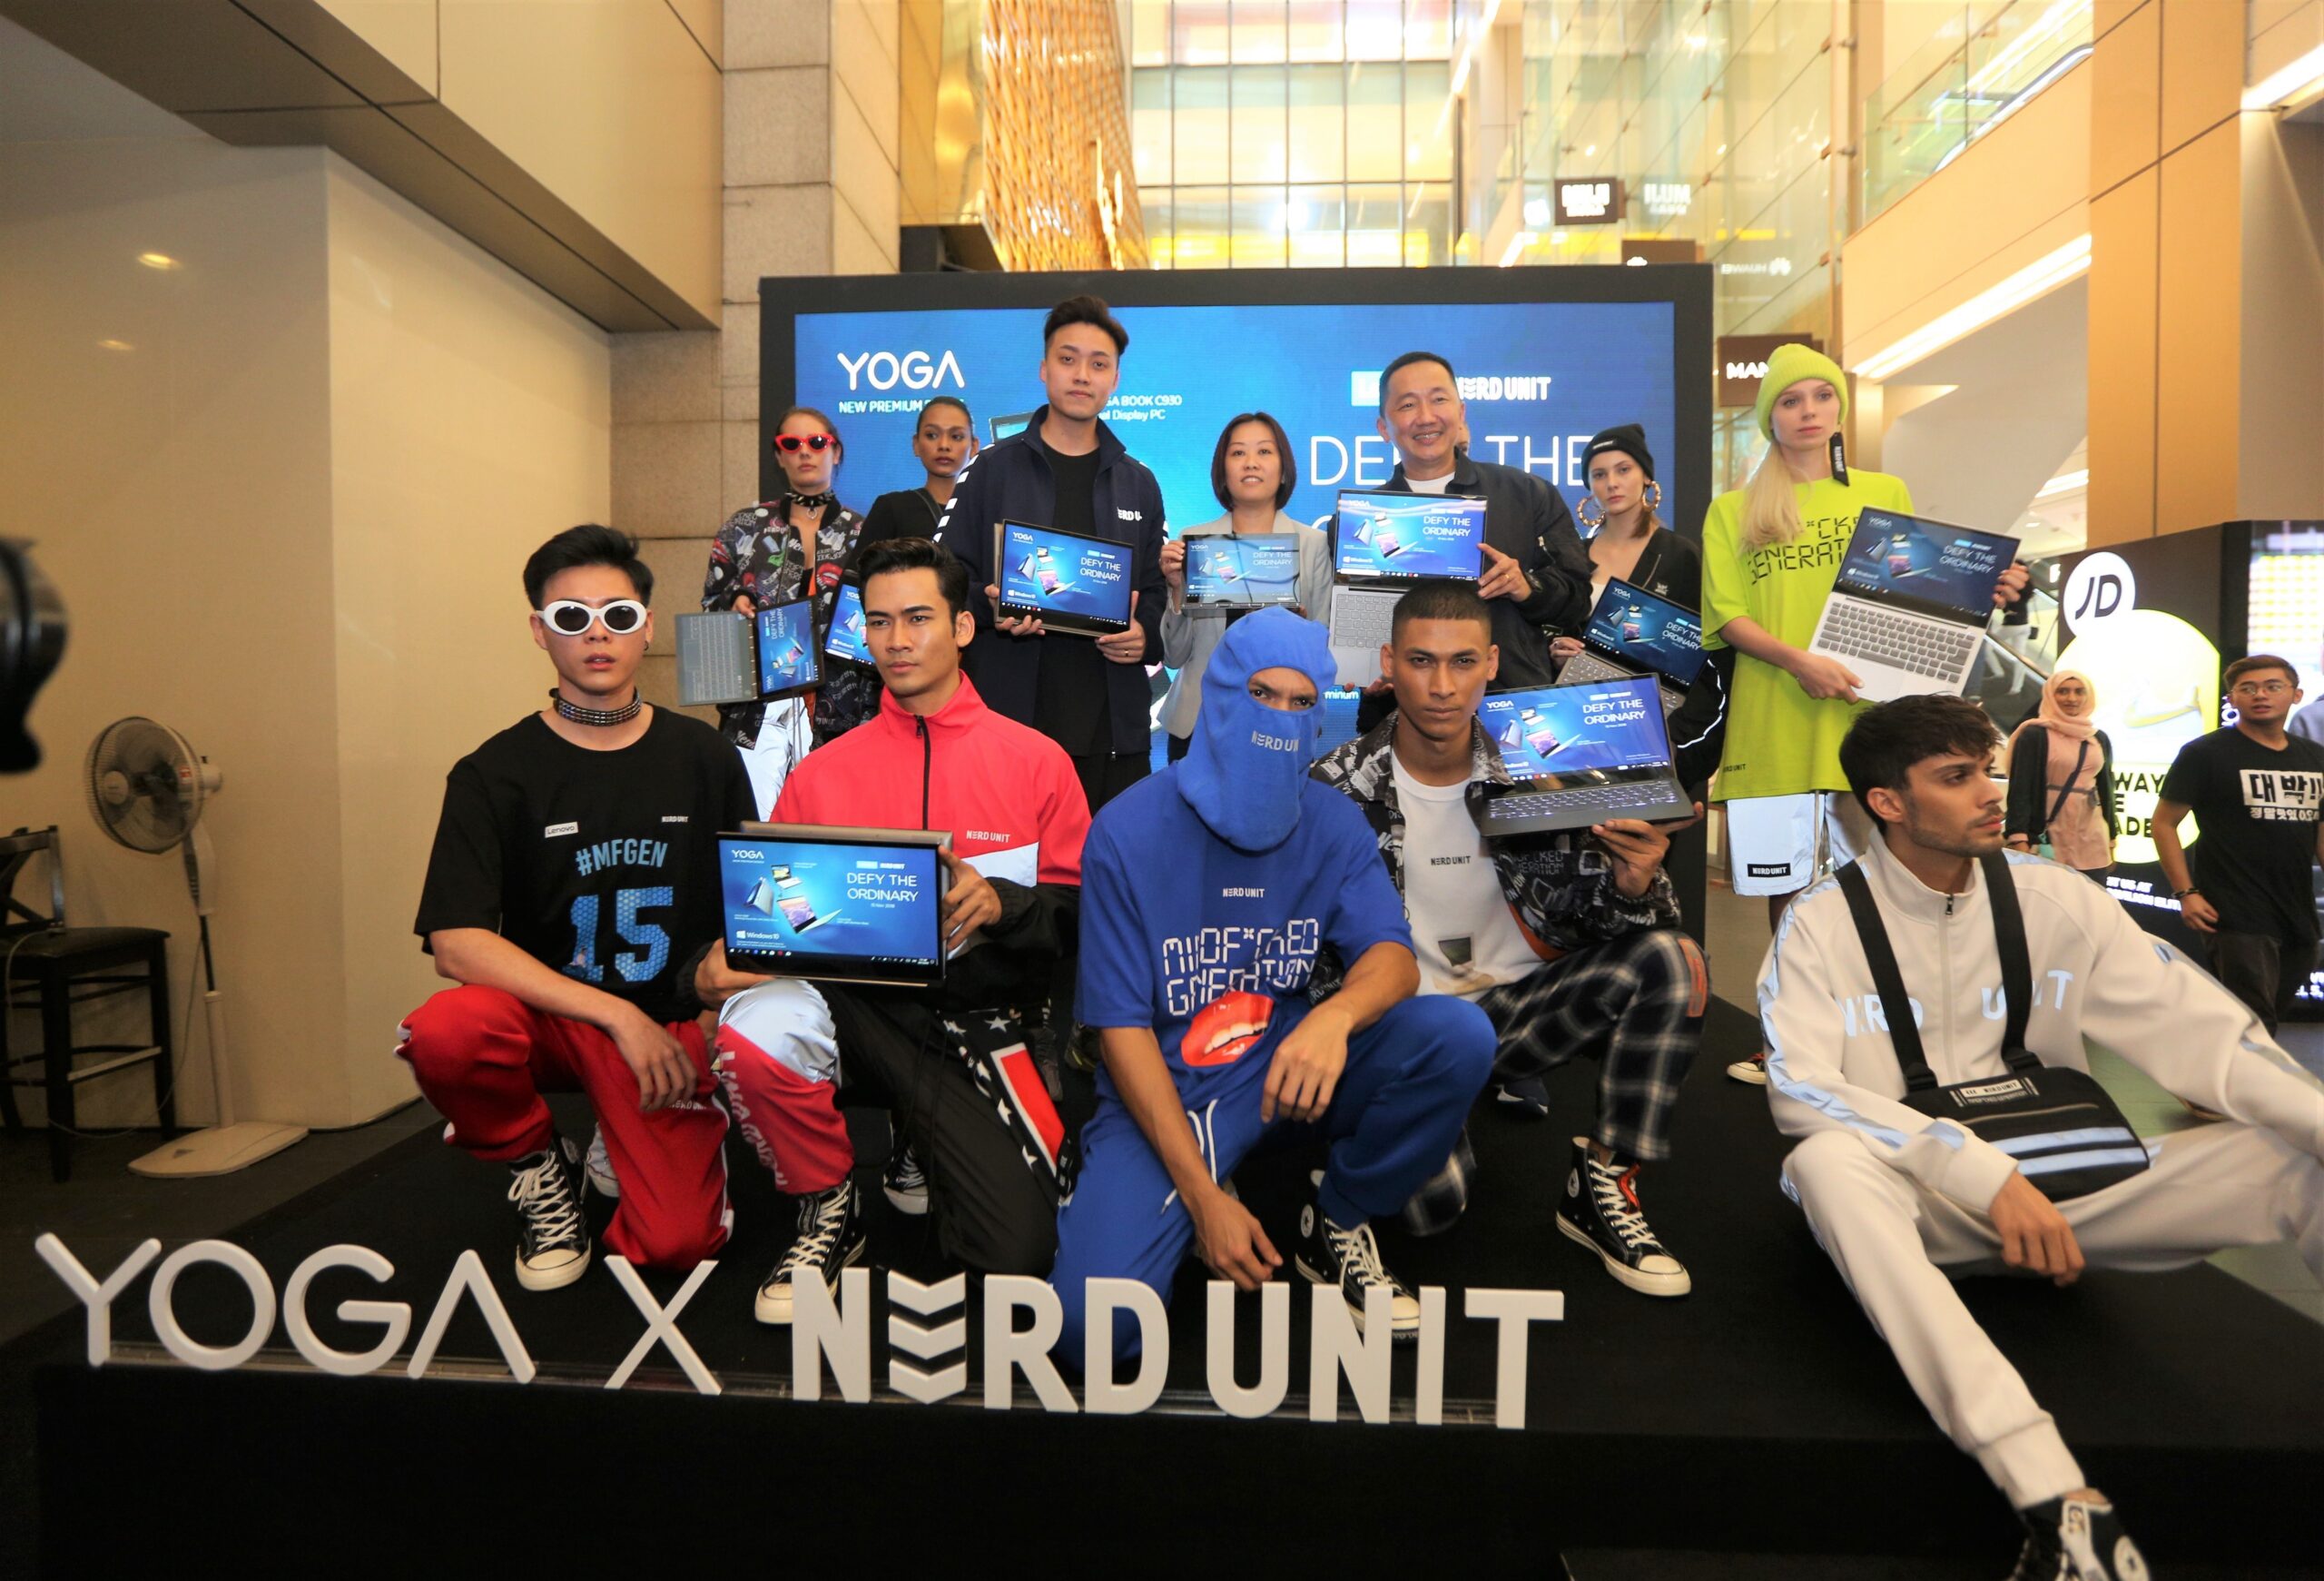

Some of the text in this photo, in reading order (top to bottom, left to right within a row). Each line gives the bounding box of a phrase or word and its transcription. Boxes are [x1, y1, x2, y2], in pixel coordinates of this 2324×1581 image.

[837, 350, 965, 391] YOGA
[1503, 376, 1552, 400] UNIT
[839, 400, 869, 414] NEW
[869, 400, 923, 413] PREMIUM
[1121, 395, 1154, 406] BOOK
[1155, 394, 1183, 407] C930
[1112, 409, 1149, 422] Display
[1149, 409, 1166, 420] PC
[1485, 435, 1593, 487] THE
[1423, 515, 1472, 527] DEFY THE
[1012, 531, 1033, 541] YOGA
[1423, 526, 1472, 538] ORDINARY
[1253, 558, 1294, 567] ORDINARY
[1943, 545, 1998, 565] DEFY THE
[1080, 557, 1122, 572] DEFY THE
[1938, 555, 1995, 574] ORDINARY
[1079, 568, 1122, 582] ORDINARY
[1613, 587, 1631, 599] YOGA
[2074, 573, 2122, 619] JD
[1666, 621, 1689, 636] DEFY
[1662, 629, 1702, 651] ORDINARY
[1324, 688, 1359, 700] minum
[1486, 700, 1514, 709] YOGA
[1582, 698, 1644, 714] DEFY THE
[1583, 710, 1646, 726] ORDINARY
[1251, 730, 1284, 751] NERD
[2115, 772, 2165, 794] WAY
[547, 824, 576, 835] Lenovo
[966, 830, 1010, 844] NERD UNIT
[576, 838, 668, 876] #MFGEN
[731, 850, 764, 860] YOGA
[1430, 855, 1472, 866] NERD UNIT
[1752, 866, 1787, 875] NERD UNIT
[846, 872, 918, 887] DEFY THE
[847, 887, 919, 902] ORDINARY
[1223, 887, 1265, 898] NERD UNIT
[565, 886, 674, 982] 15
[34, 1231, 1565, 1430] YOGA X NERD UNIT
